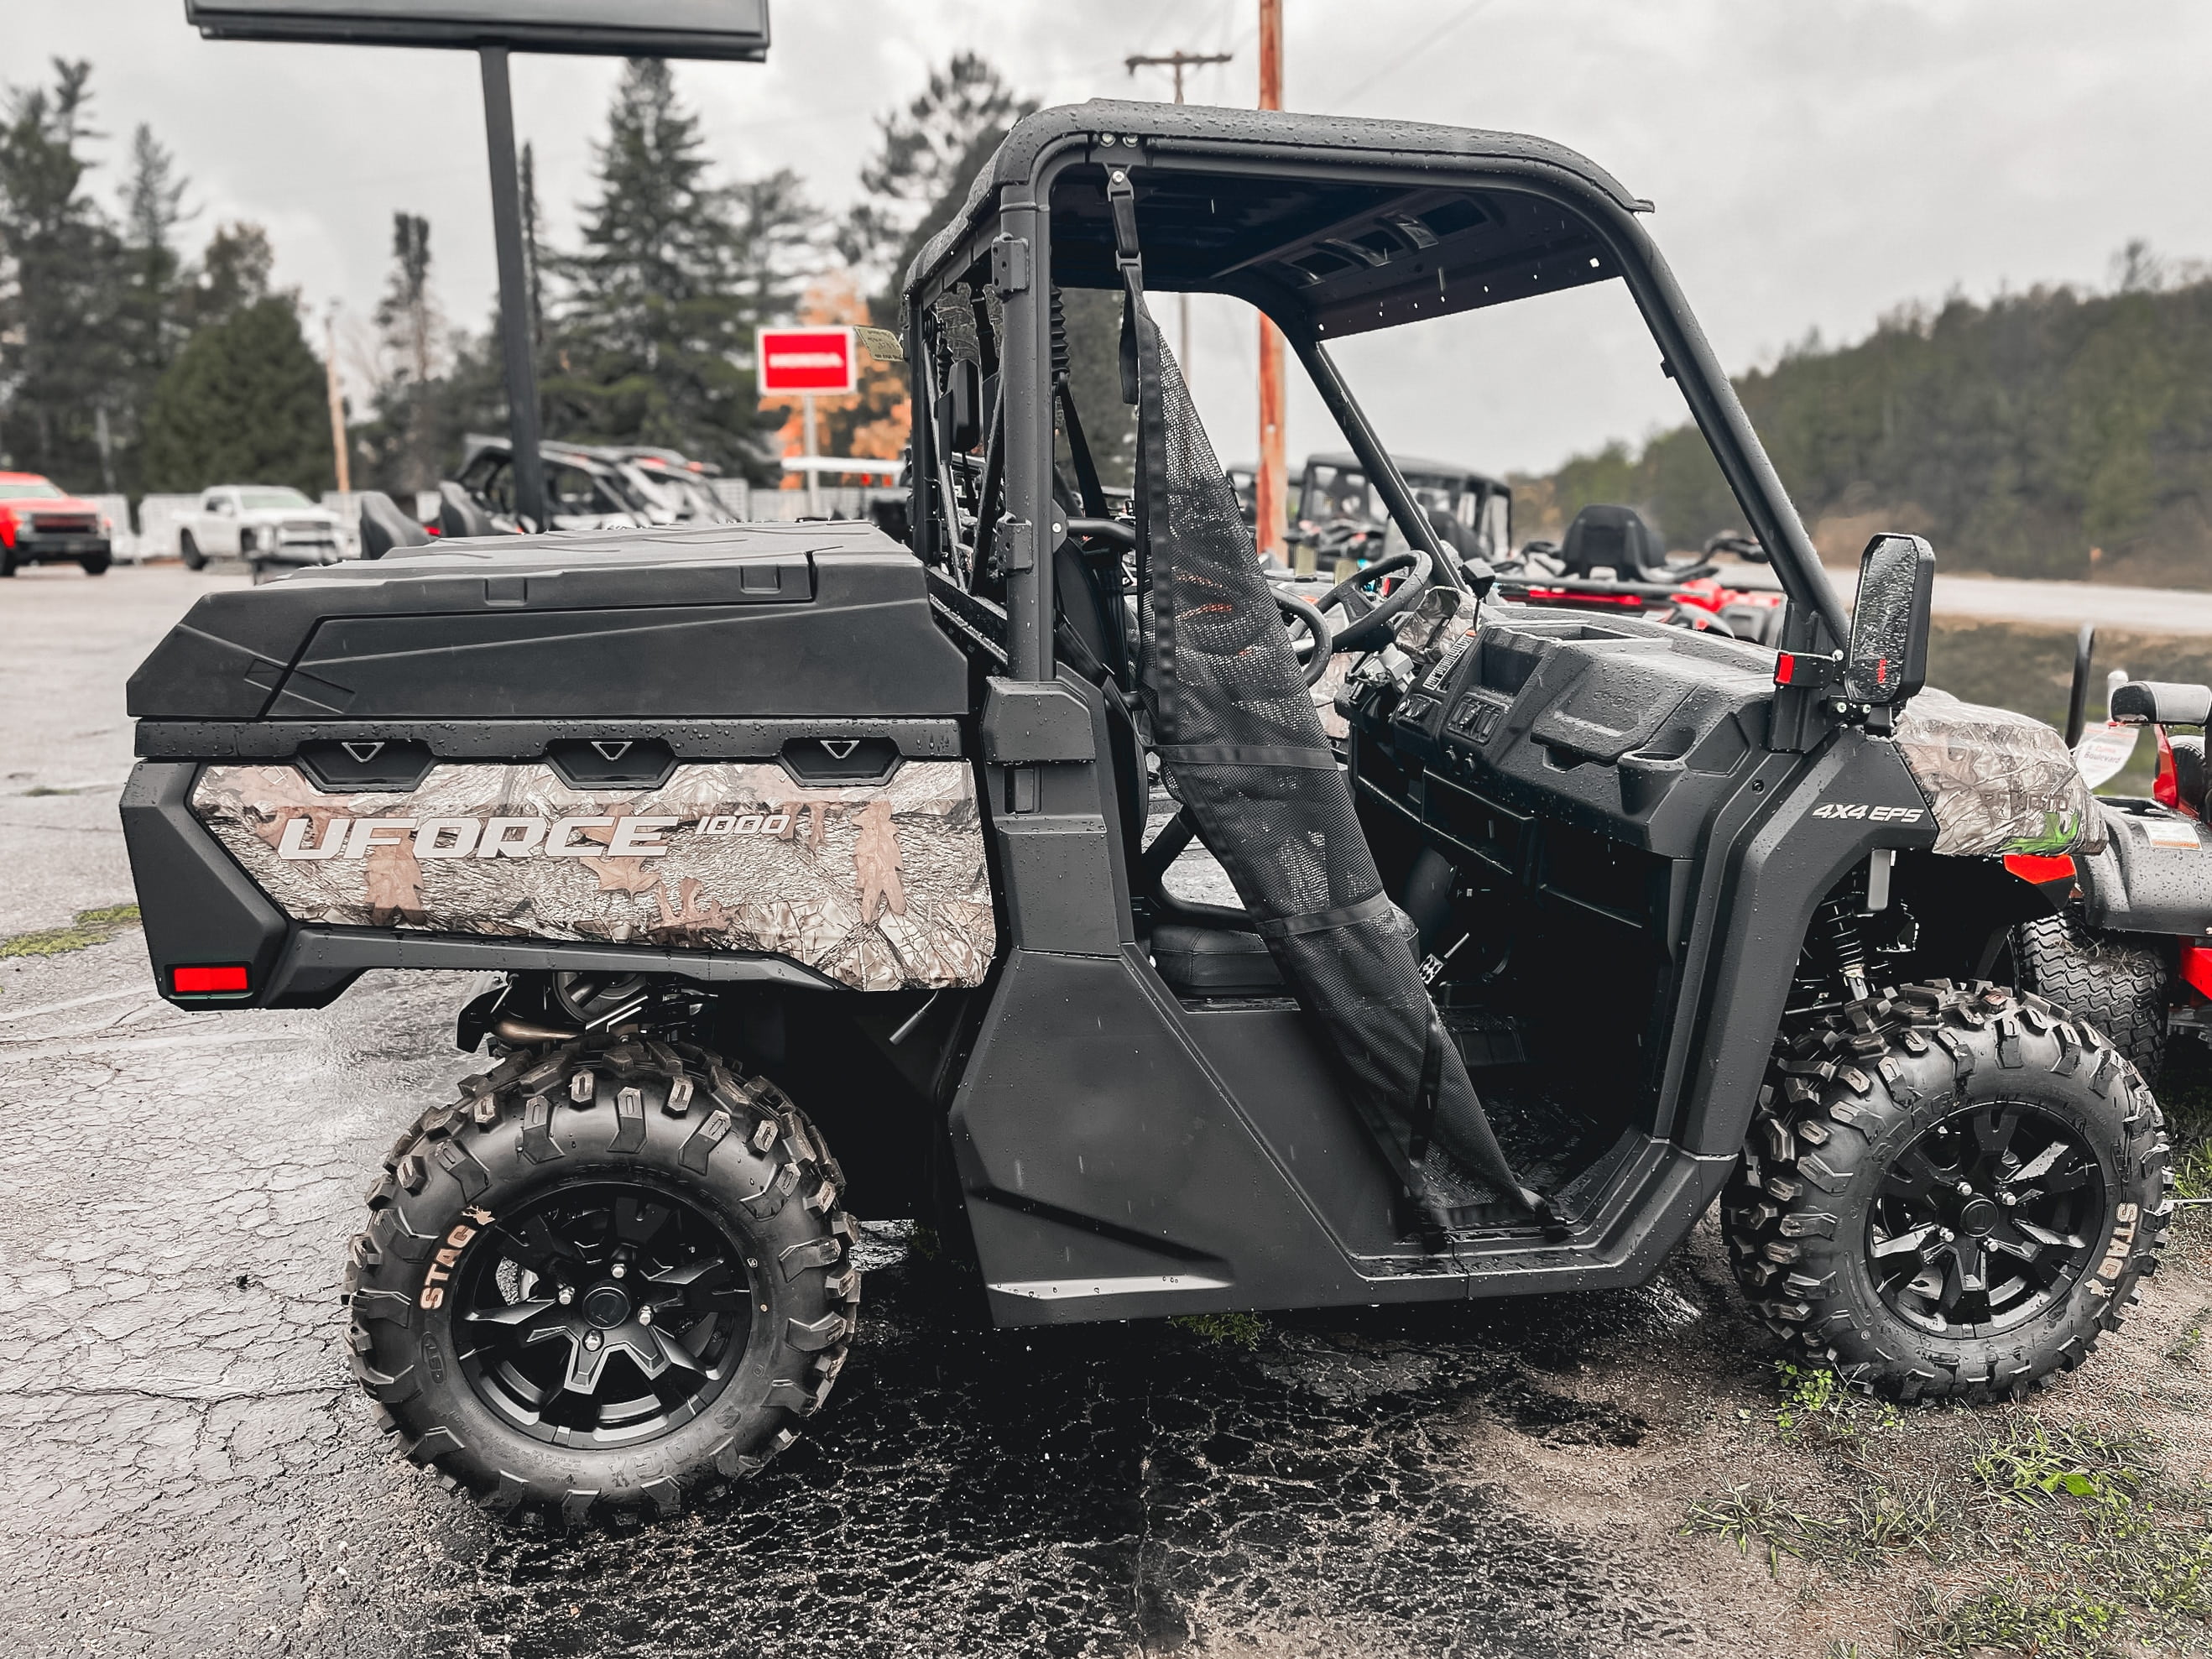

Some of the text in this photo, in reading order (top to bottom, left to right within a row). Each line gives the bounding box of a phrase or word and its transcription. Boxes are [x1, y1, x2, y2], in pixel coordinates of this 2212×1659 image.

[277, 814, 791, 860] UFORCE 1000
[1812, 803, 1925, 823] 4X4 EPS
[420, 1224, 477, 1310] STAG
[2096, 1202, 2139, 1280] STAG
